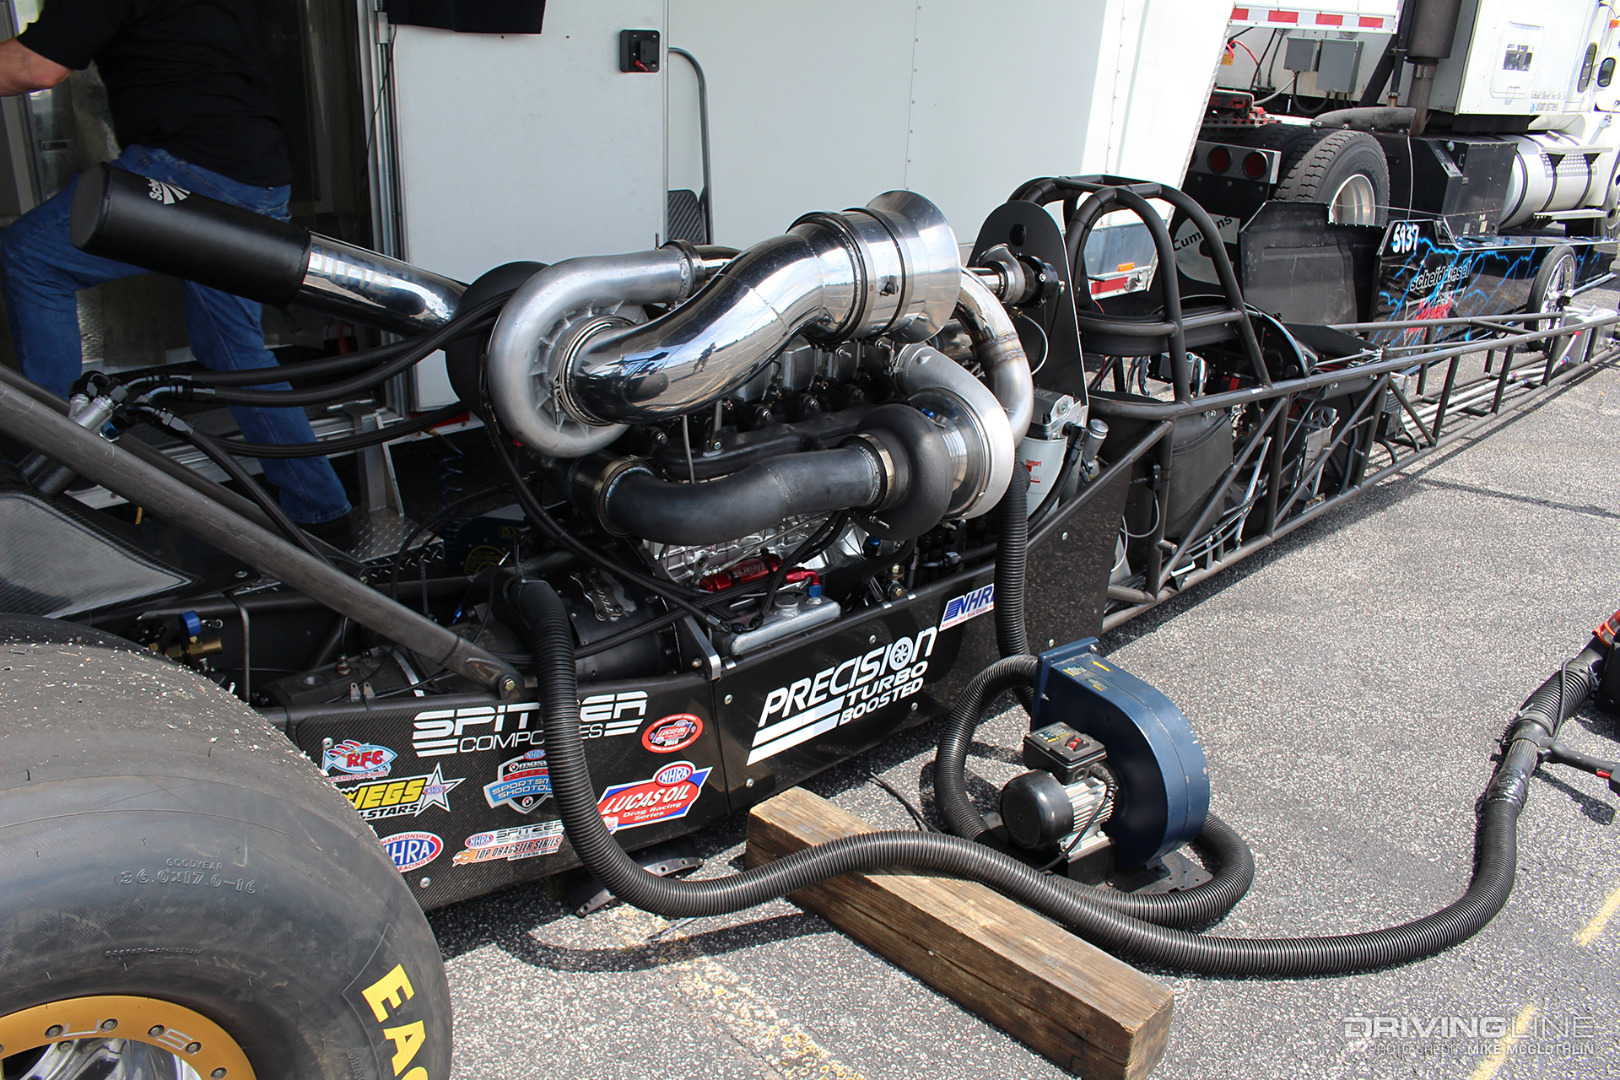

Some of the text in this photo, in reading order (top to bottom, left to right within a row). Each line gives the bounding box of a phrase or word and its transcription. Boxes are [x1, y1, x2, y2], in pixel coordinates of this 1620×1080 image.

[1173, 216, 1233, 251] Cumns
[944, 585, 994, 621] NHR
[758, 626, 937, 728] PRECISION
[847, 660, 929, 707] TURBO
[839, 677, 924, 726] BOOSTED
[412, 691, 648, 739] SPITER
[459, 724, 603, 753] COMPOES
[347, 751, 384, 767] RFC
[661, 767, 690, 784] NHRA
[355, 778, 427, 810] JEGS
[601, 784, 692, 815] LUCAS OIL
[623, 802, 682, 818] Drag Racing
[634, 811, 664, 821] Series
[381, 833, 430, 845] HAMPIONSHIP
[469, 835, 491, 847] NHRA
[475, 837, 561, 860] TOP DRAGSTER SERIES
[166, 858, 223, 871] GOODYEAR
[398, 860, 426, 871] RACING
